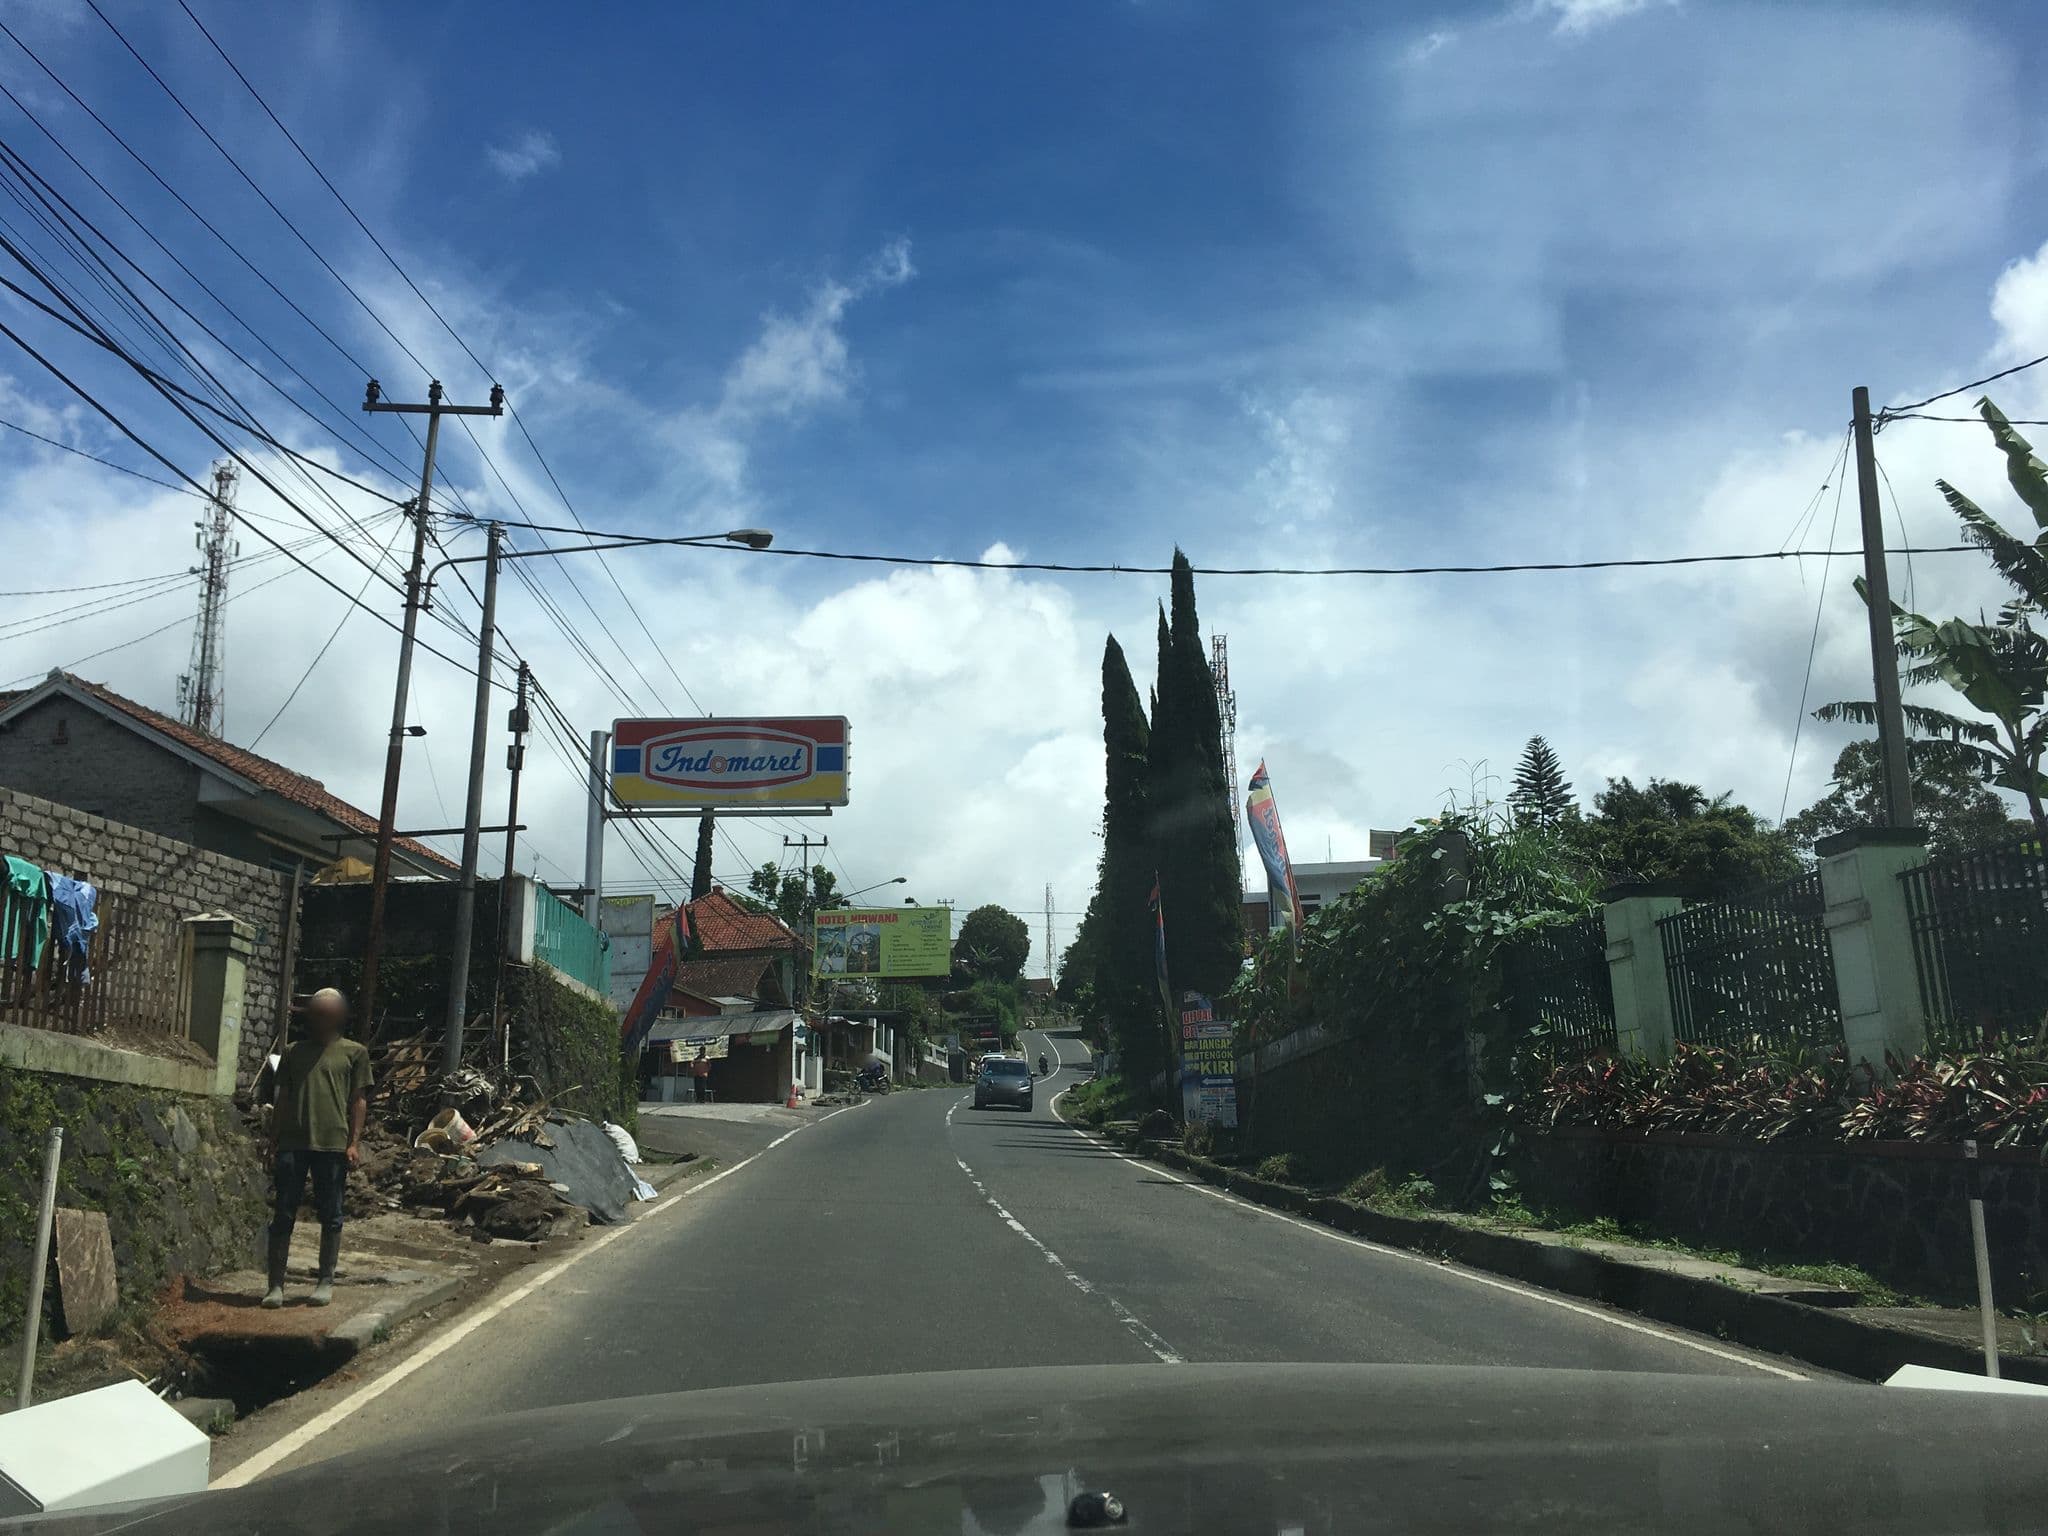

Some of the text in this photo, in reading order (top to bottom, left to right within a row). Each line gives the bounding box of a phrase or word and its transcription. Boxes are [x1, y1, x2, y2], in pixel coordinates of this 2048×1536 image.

[655, 746, 802, 774] Indomaret
[817, 915, 847, 925] HOTEL
[851, 913, 898, 924] NIRWANA
[1200, 1050, 1233, 1060] TENGOK
[1200, 1060, 1233, 1075] KIRI
